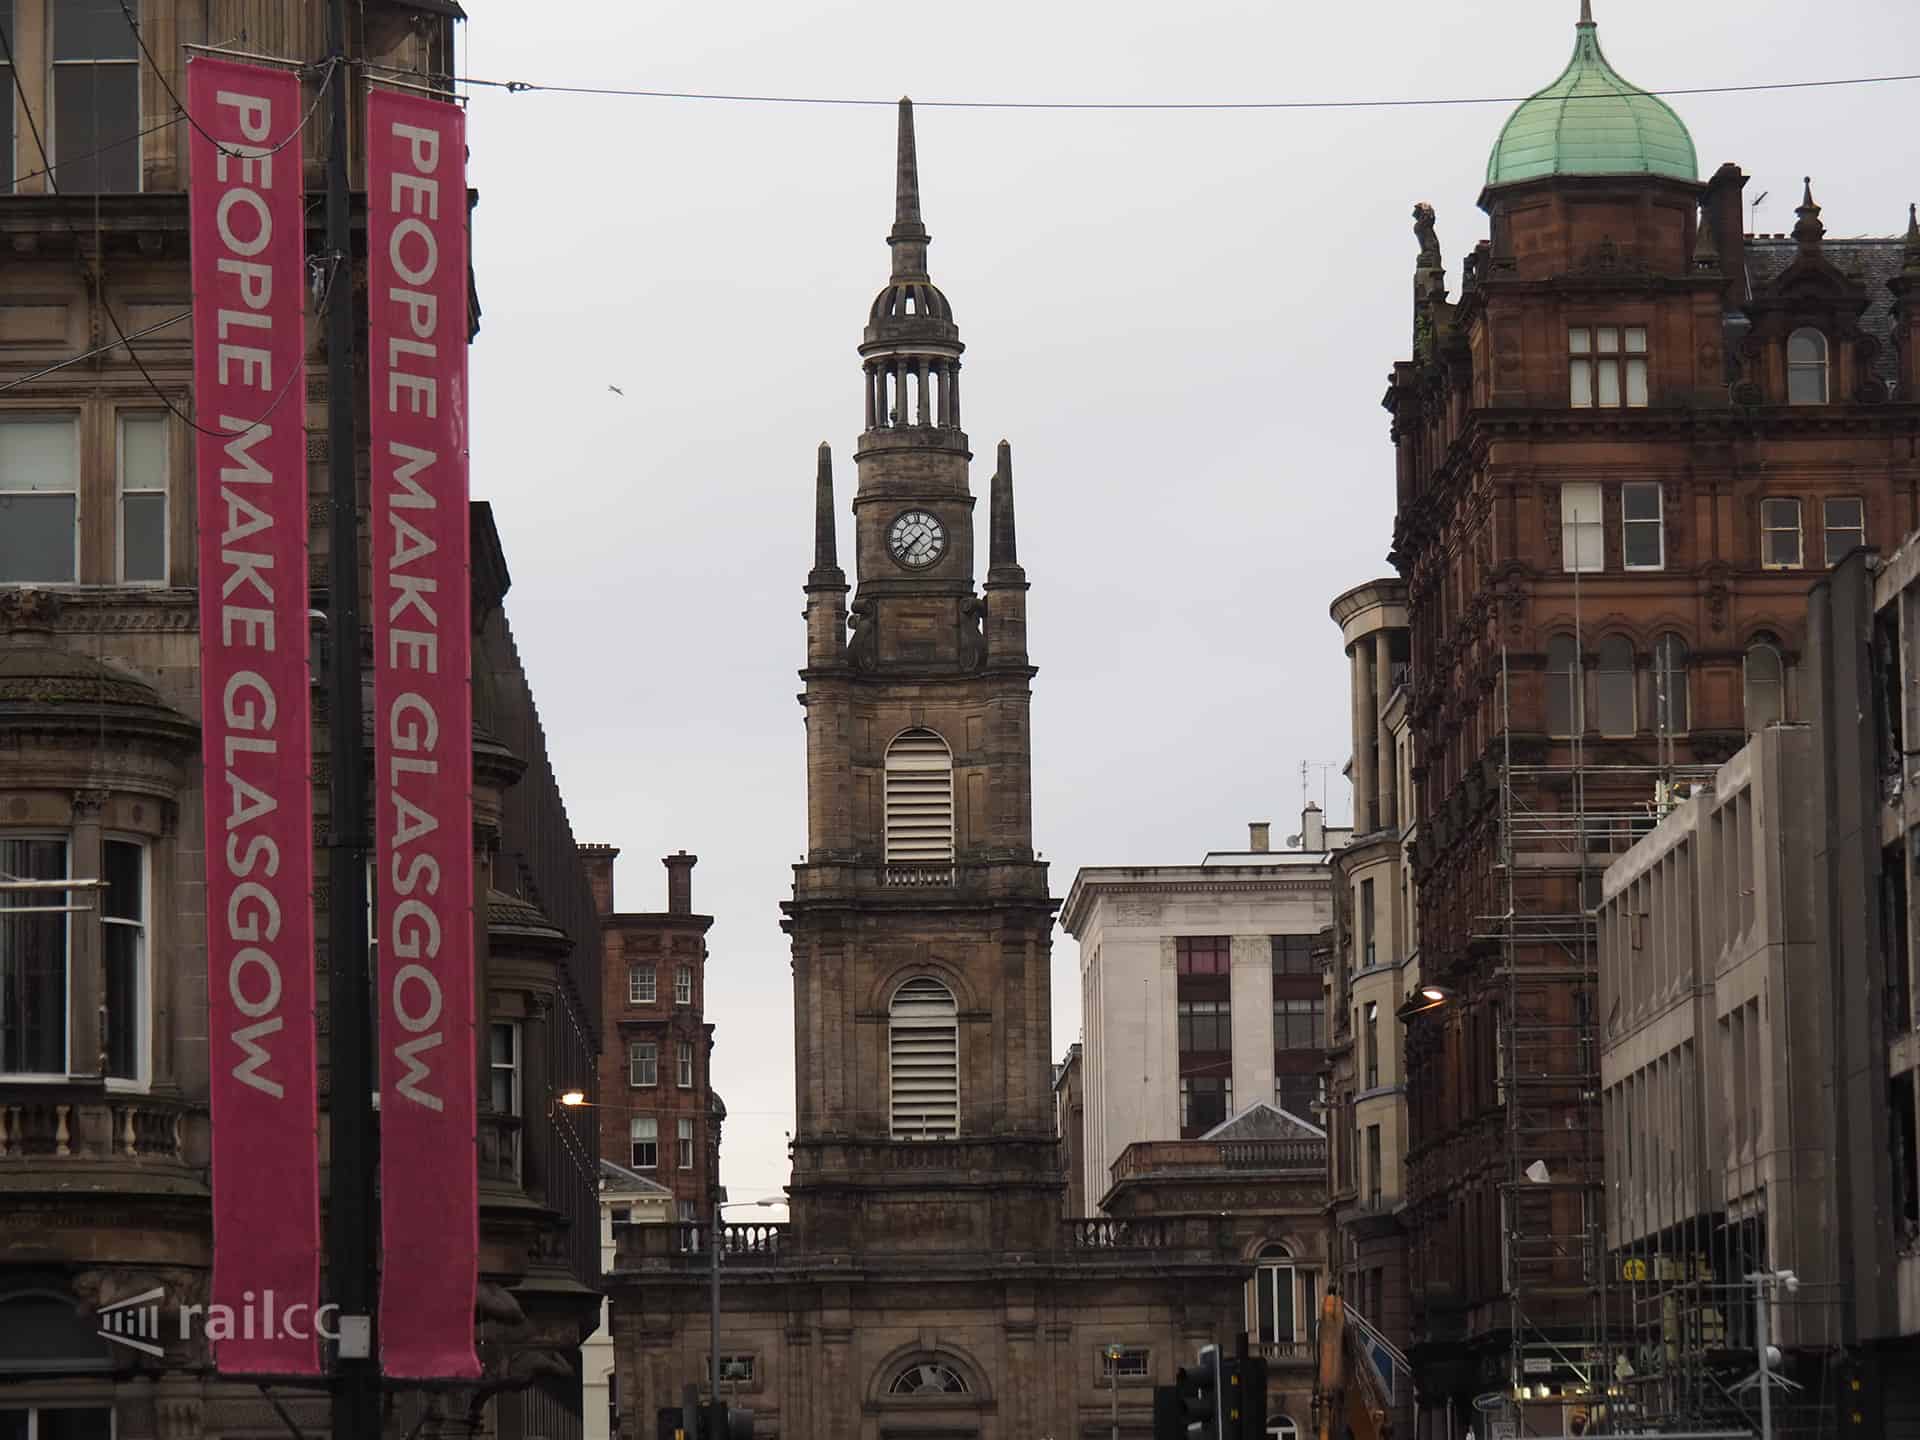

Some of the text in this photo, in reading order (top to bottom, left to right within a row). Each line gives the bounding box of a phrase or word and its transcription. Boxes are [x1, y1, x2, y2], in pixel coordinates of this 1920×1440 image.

[216, 90, 284, 1099] PEOPLE MAKE GLASGOW
[389, 121, 444, 1112] PEOPLE MAKE GLASGOW
